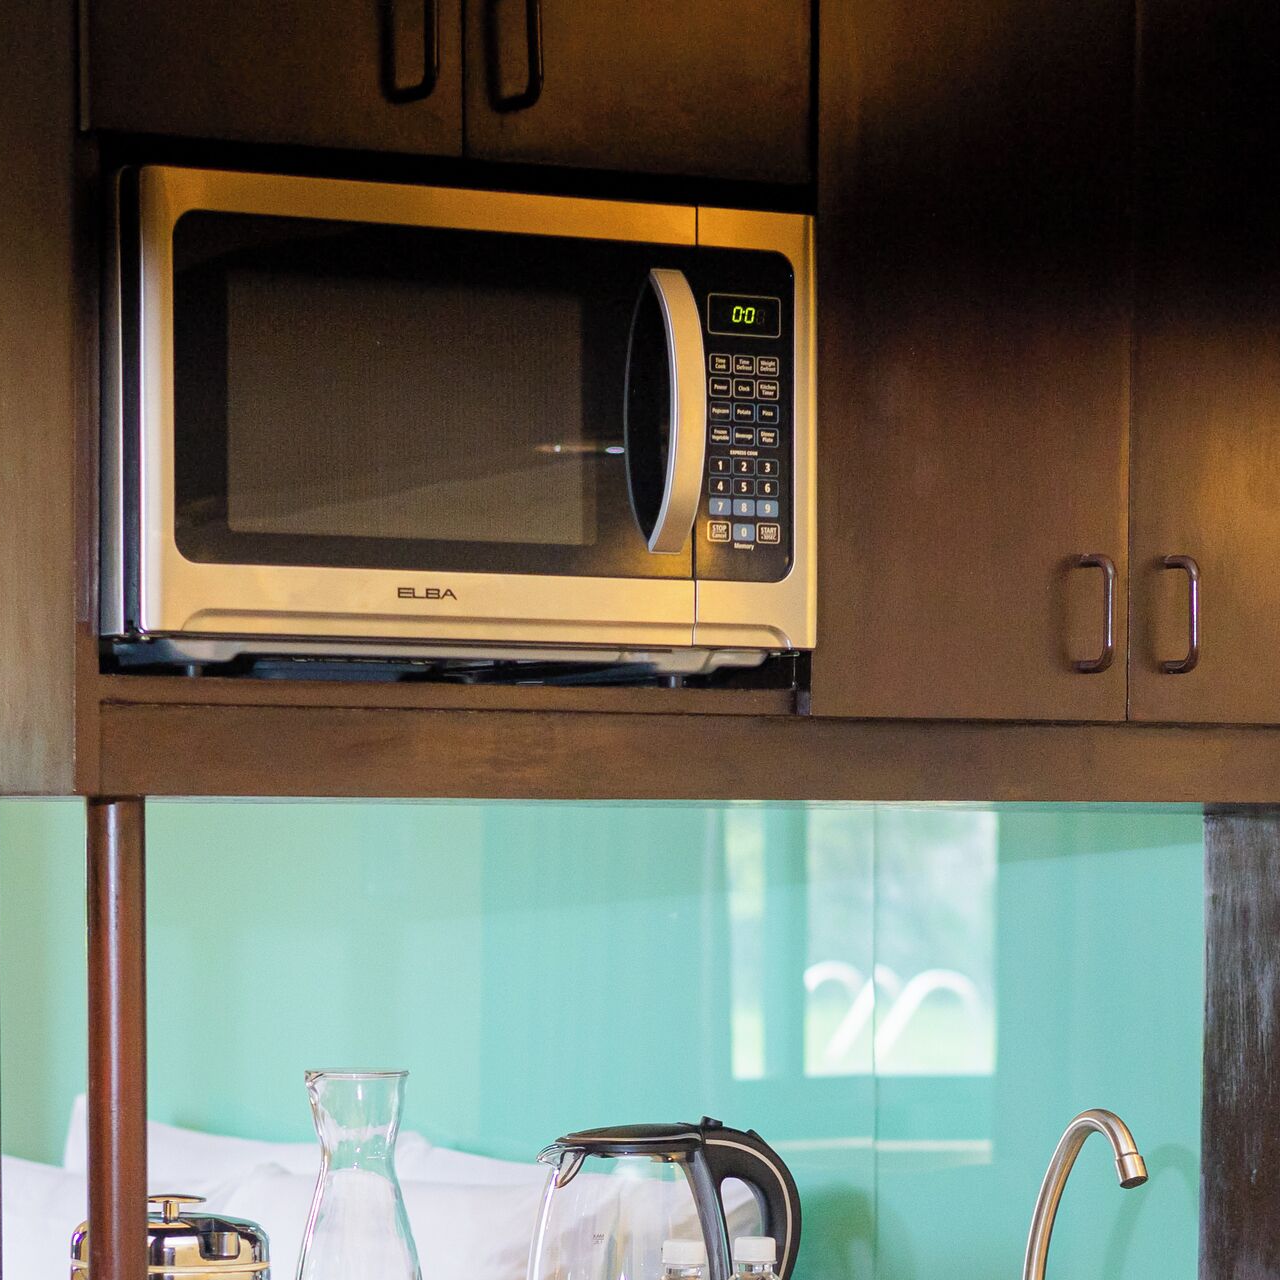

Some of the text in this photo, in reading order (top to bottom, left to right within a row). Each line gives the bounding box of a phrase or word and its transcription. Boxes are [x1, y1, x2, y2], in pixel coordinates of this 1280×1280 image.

[718, 461, 723, 471] 1
[741, 462, 747, 472] 2
[765, 463, 771, 473] 3
[717, 481, 724, 491] 4
[741, 482, 747, 492] 5
[764, 483, 771, 493] 6
[718, 502, 724, 512] 7
[741, 502, 747, 513] 8
[764, 503, 771, 514] 9
[741, 527, 747, 537] 0
[734, 543, 754, 551] Memory
[398, 587, 457, 600] ELBA
